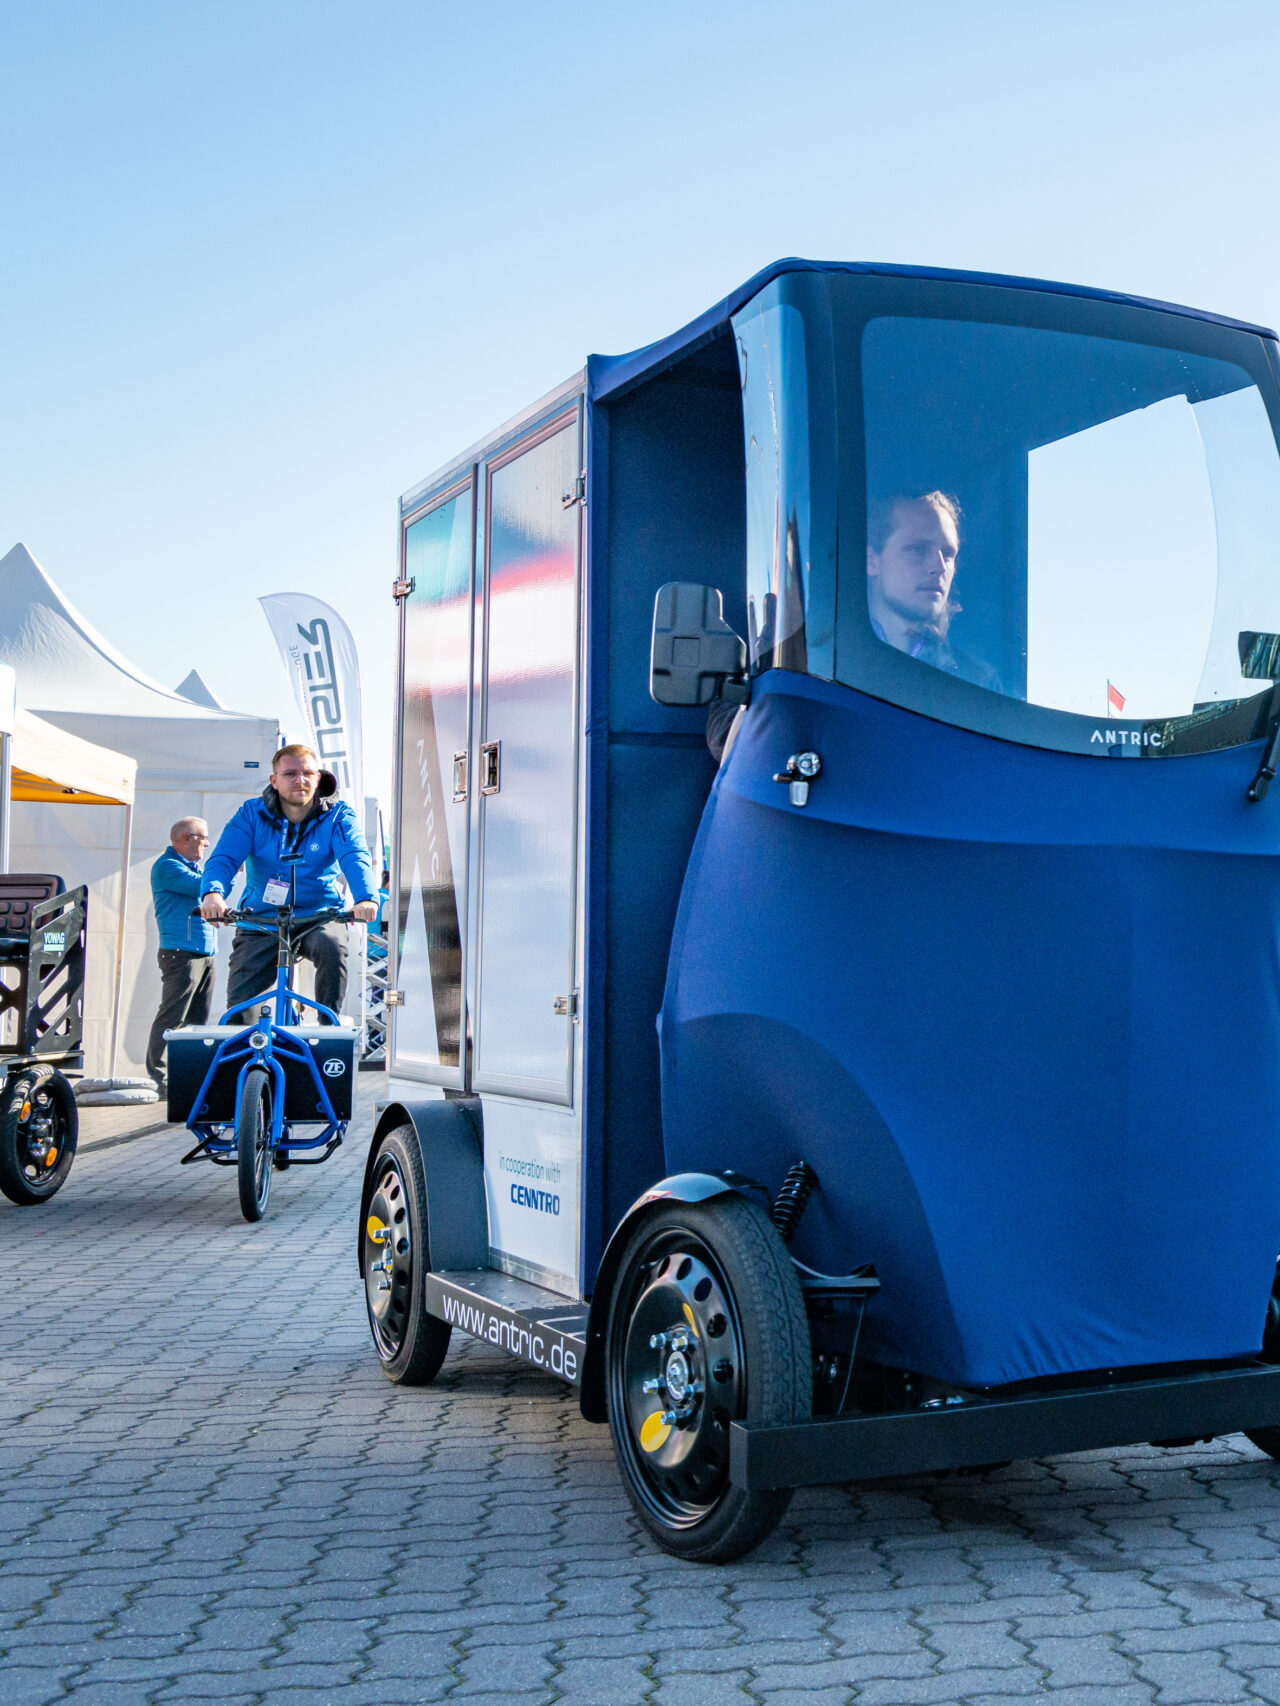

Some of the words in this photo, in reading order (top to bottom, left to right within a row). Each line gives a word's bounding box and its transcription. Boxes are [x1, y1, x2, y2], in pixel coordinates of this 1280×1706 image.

[1090, 729, 1162, 747] ANTRIC
[511, 1183, 560, 1216] CENNTRO
[443, 1294, 577, 1380] www.antric.de
